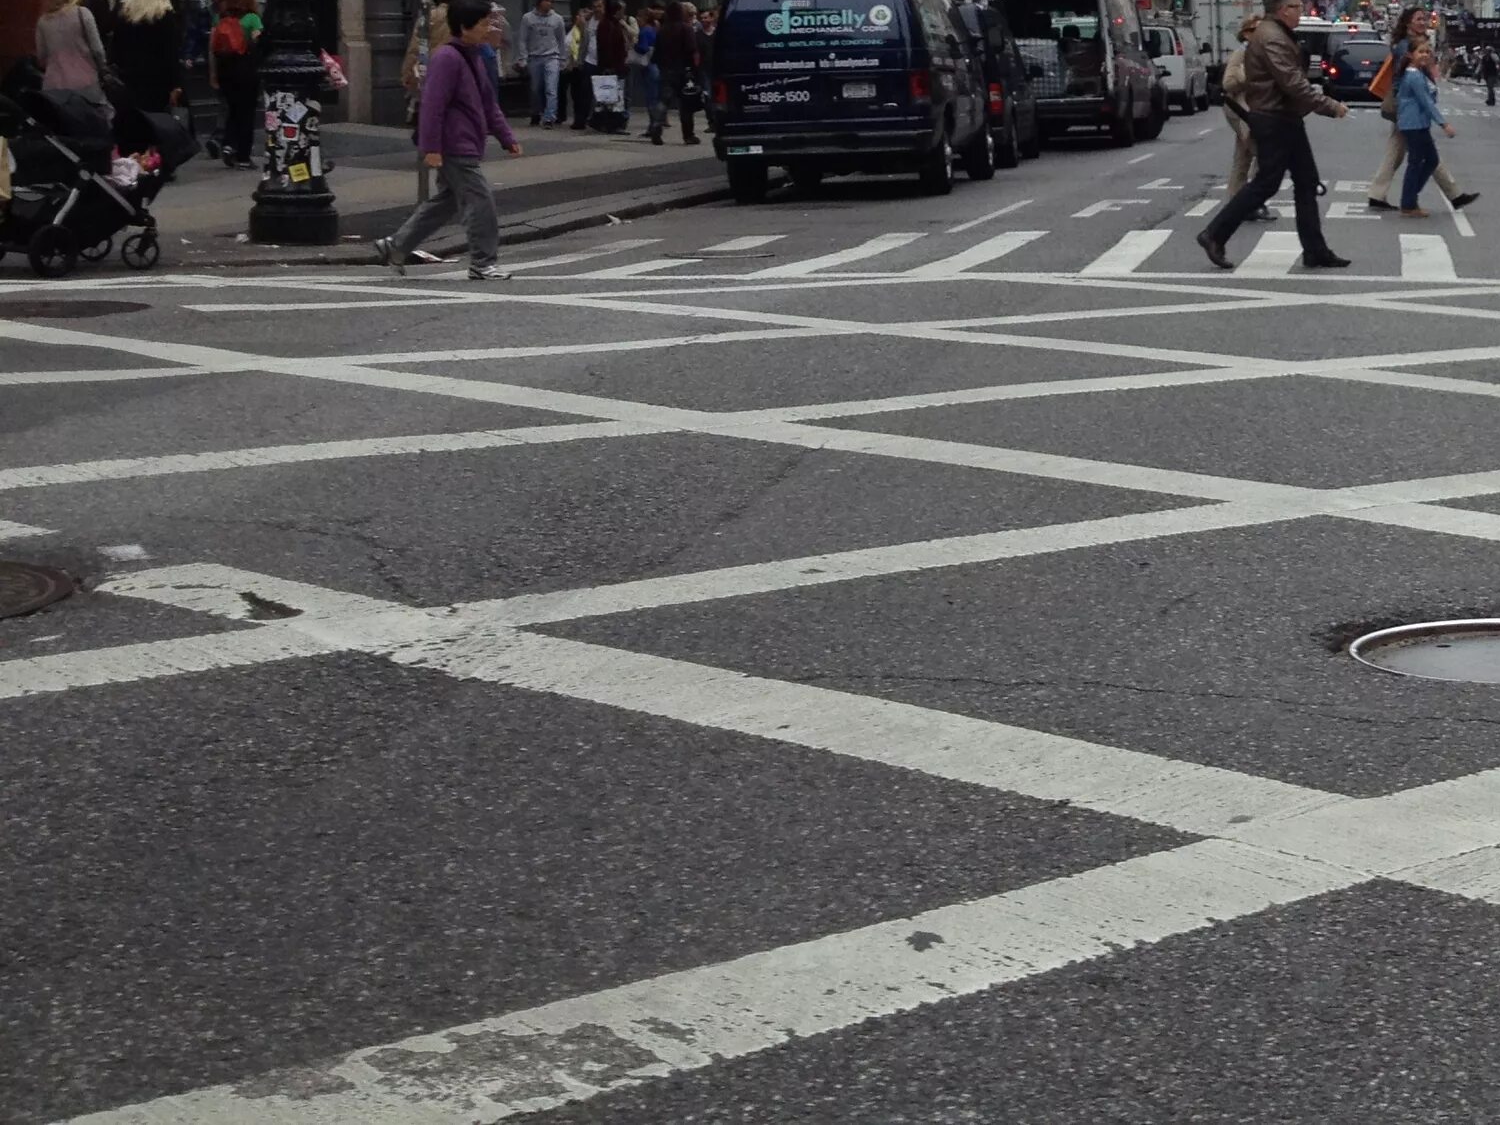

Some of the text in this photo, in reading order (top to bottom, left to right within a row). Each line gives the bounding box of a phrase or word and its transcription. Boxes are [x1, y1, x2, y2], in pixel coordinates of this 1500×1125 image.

[765, 0, 867, 35] donnelly
[790, 26, 854, 34] MECHANICAL
[760, 90, 810, 103] 886-1500
